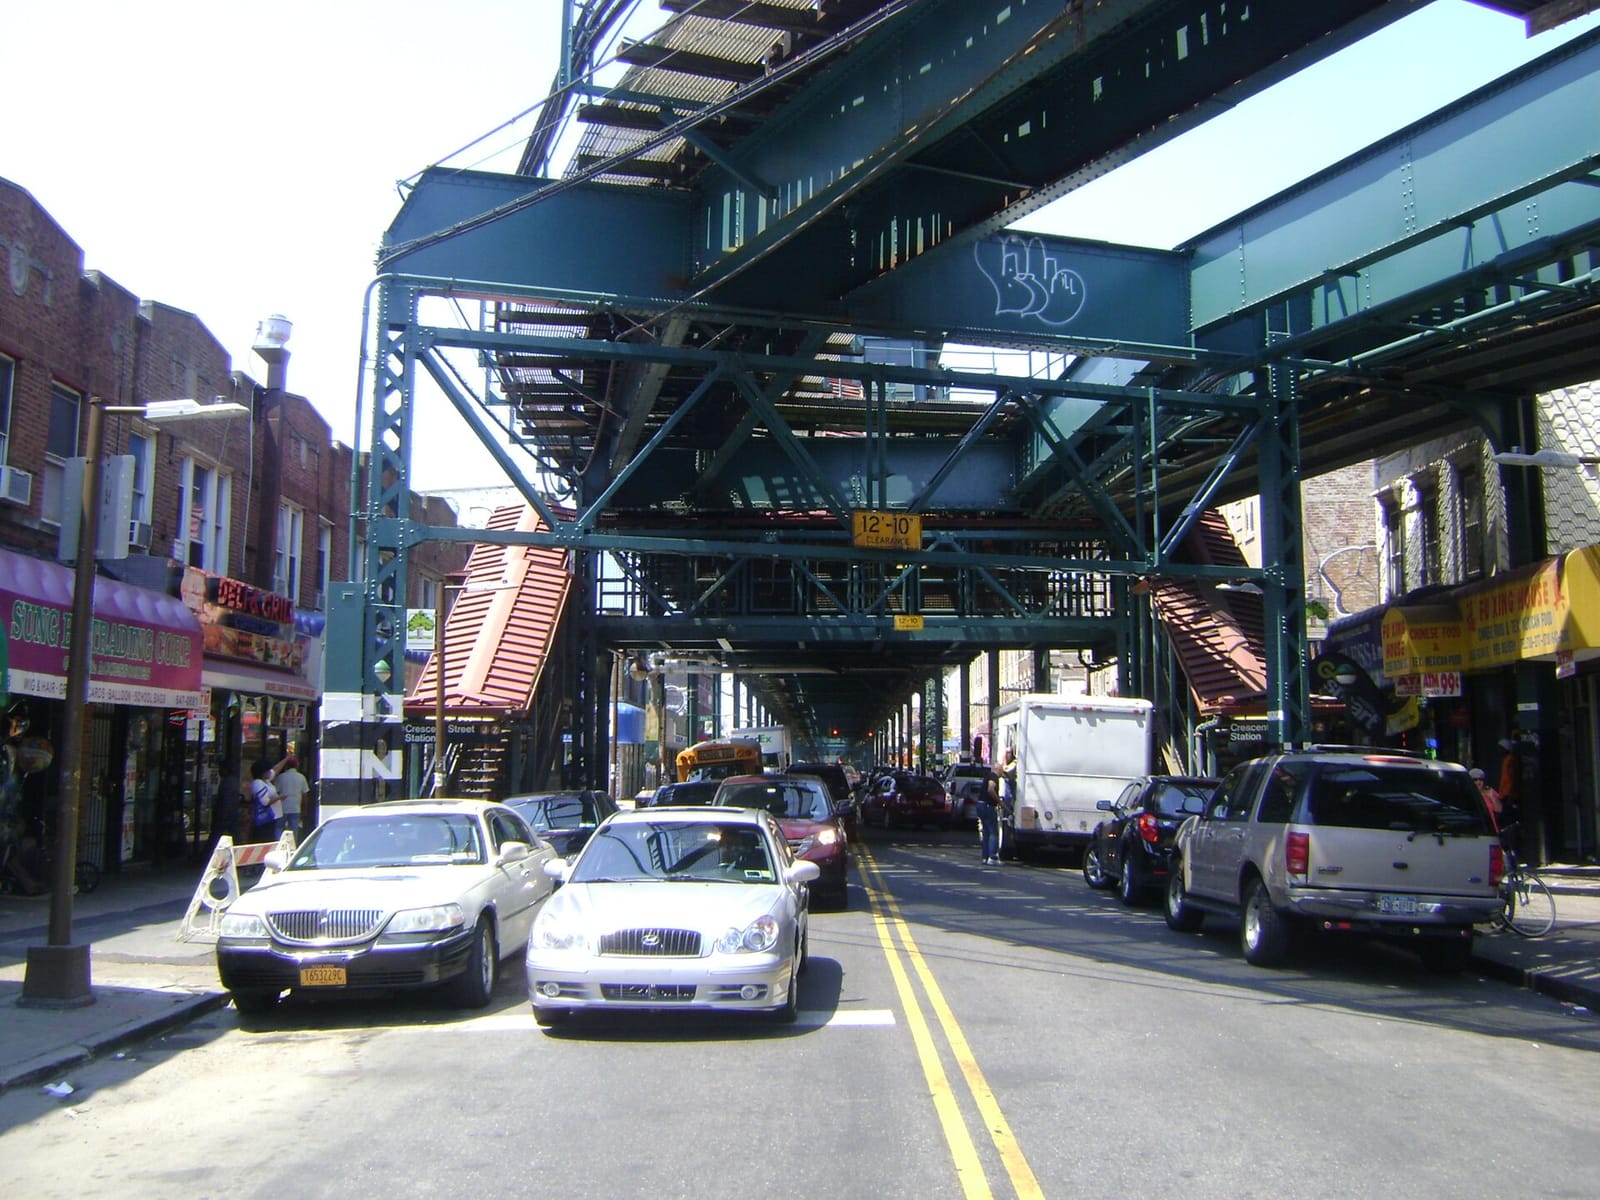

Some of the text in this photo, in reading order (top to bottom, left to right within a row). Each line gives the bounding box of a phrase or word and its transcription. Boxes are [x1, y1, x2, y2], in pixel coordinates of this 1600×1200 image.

[866, 535, 911, 546] CLEARANCE
[1517, 580, 1549, 611] HOUSE
[10, 599, 60, 648] SUNG
[405, 724, 436, 734] Cresce
[448, 724, 475, 734] Street
[405, 733, 436, 743] Station
[1230, 732, 1262, 741] Station
